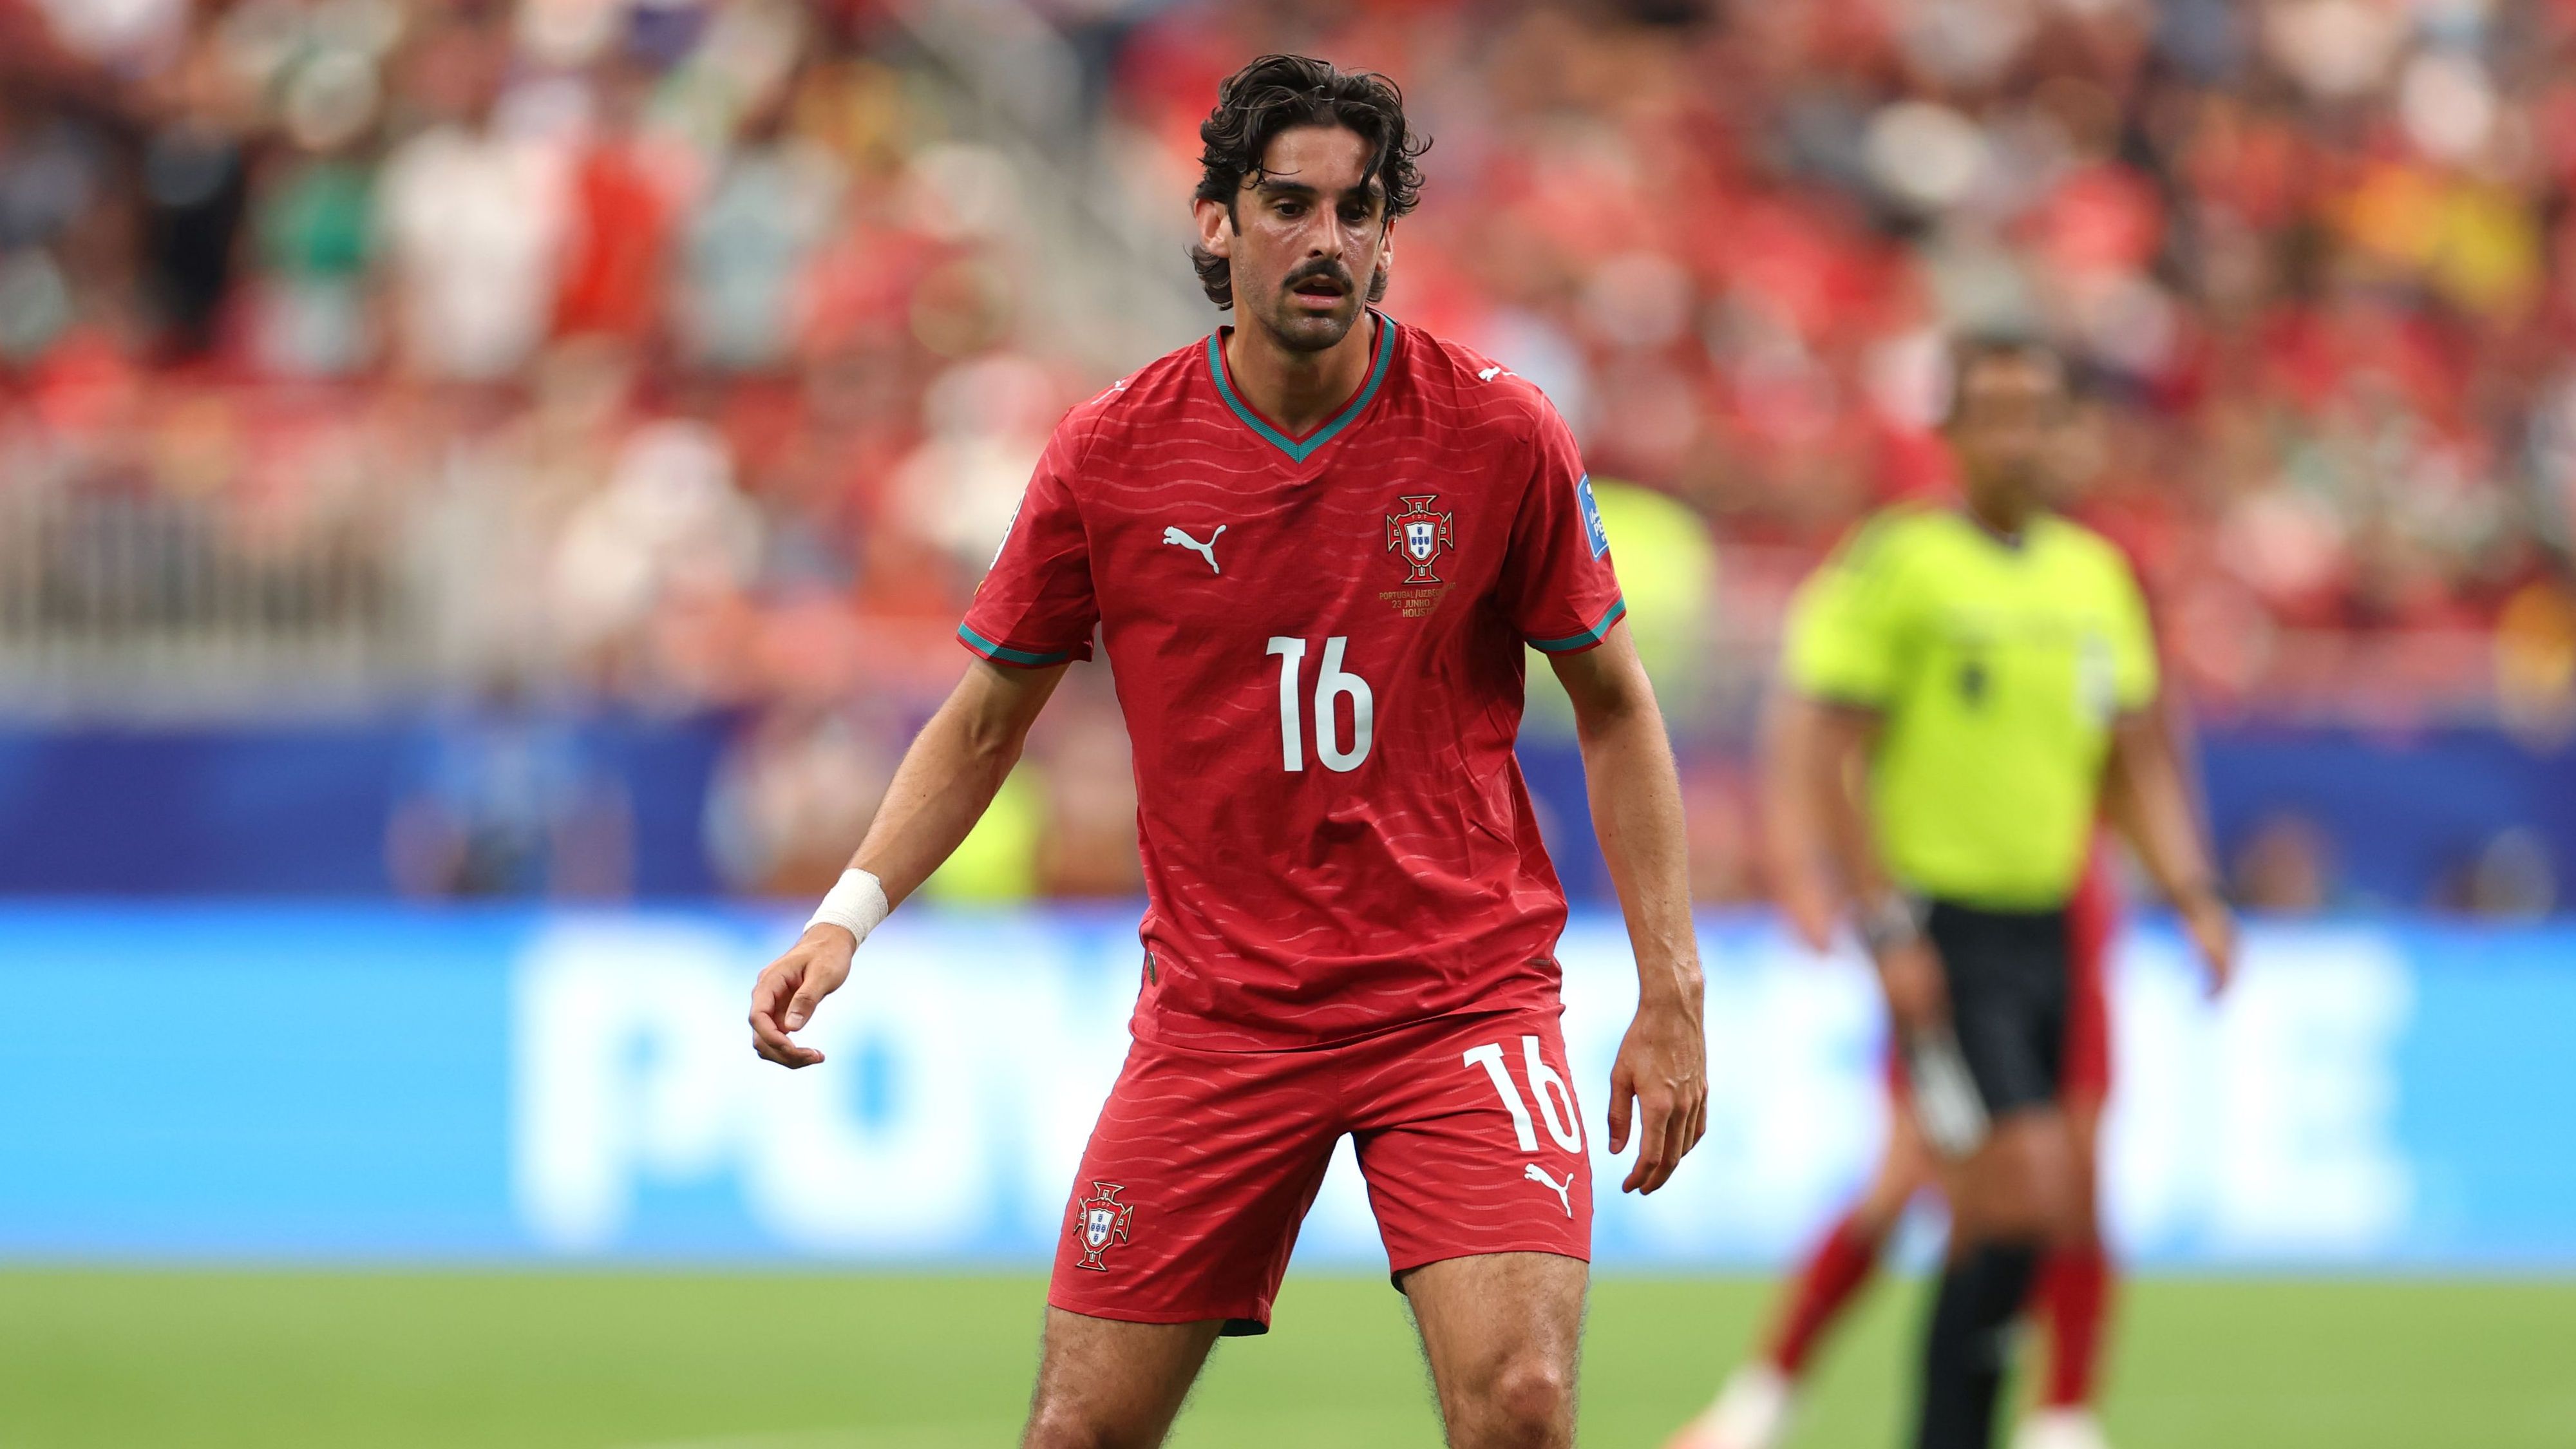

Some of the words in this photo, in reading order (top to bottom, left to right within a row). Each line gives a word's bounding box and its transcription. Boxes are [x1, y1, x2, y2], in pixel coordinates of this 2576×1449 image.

[1392, 600, 1402, 609] 23
[1404, 599, 1430, 608] JUNHO
[1266, 636, 1373, 772] 16
[1463, 1035, 1582, 1153] 16
